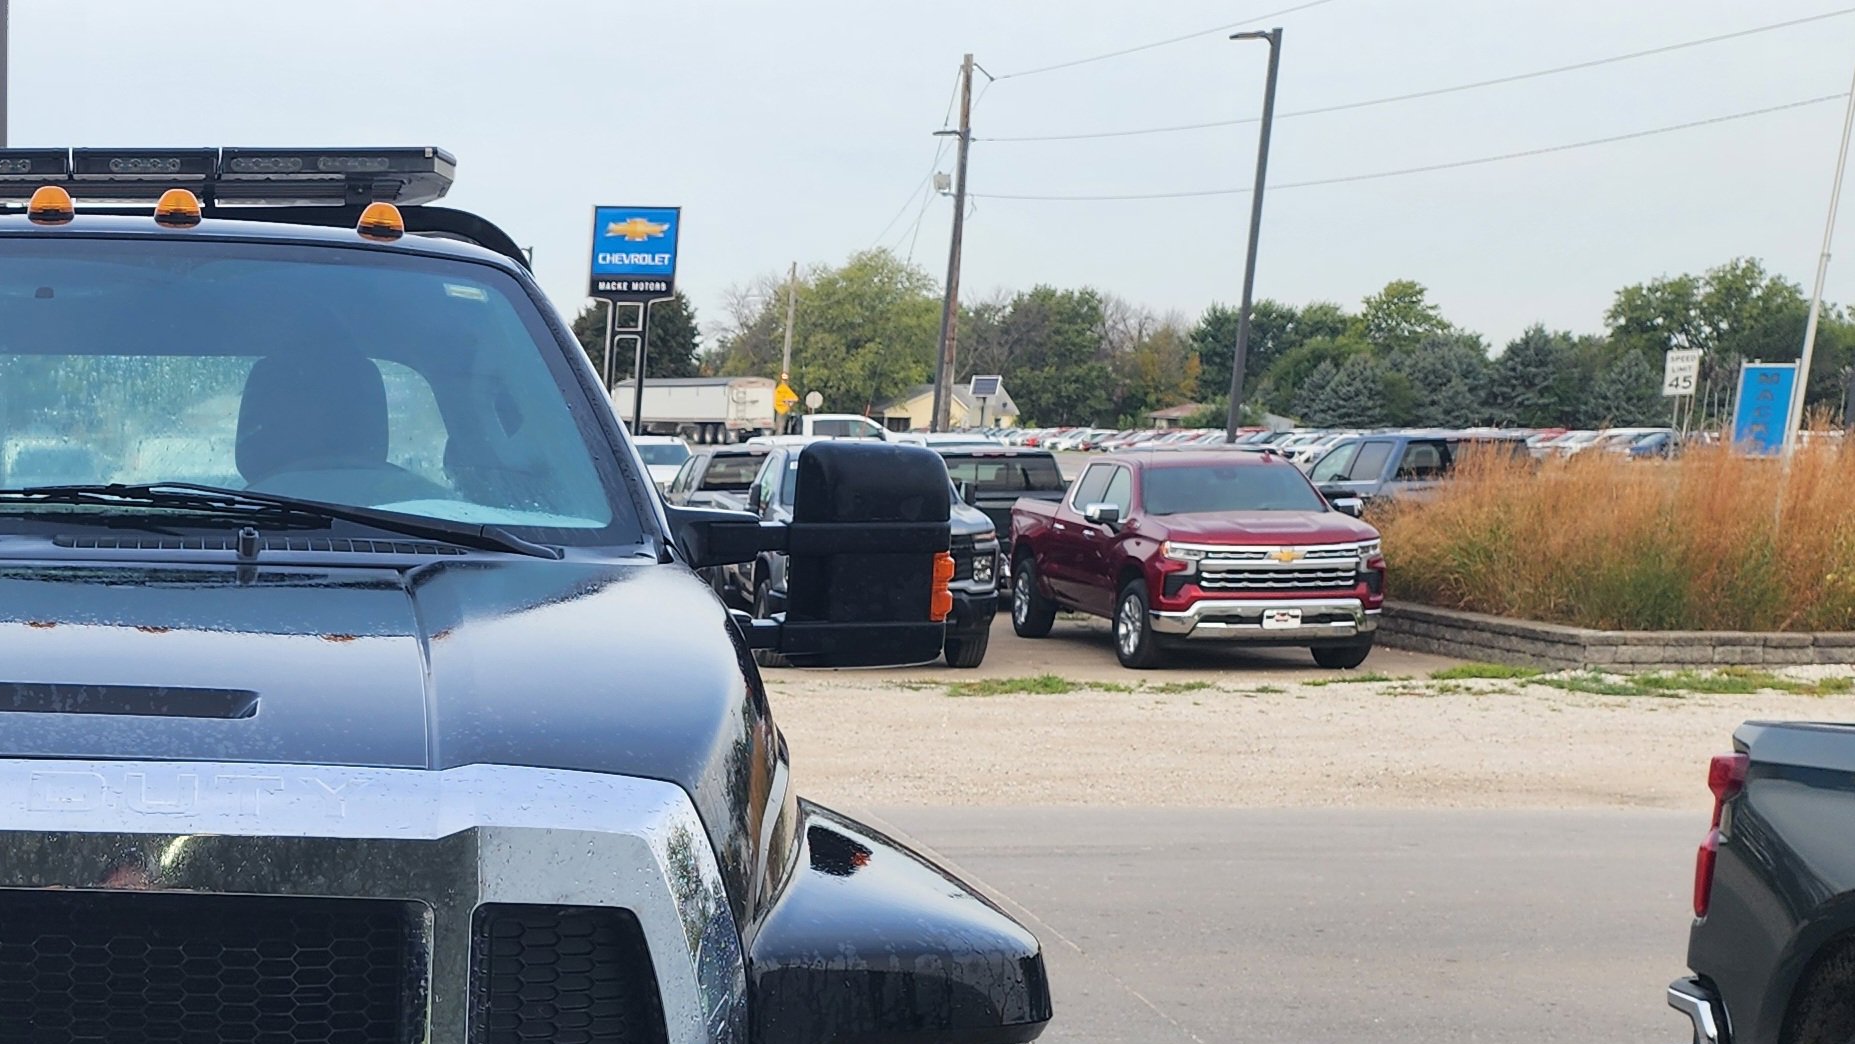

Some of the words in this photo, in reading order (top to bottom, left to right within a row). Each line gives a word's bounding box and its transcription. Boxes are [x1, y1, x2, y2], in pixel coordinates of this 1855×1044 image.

[597, 252, 671, 265] CHEVROLET
[598, 281, 628, 291] MACKE
[631, 281, 667, 292] MOTORS
[1671, 365, 1692, 373] LIMIT
[1668, 375, 1692, 389] 45
[25, 768, 376, 819] DUTY
